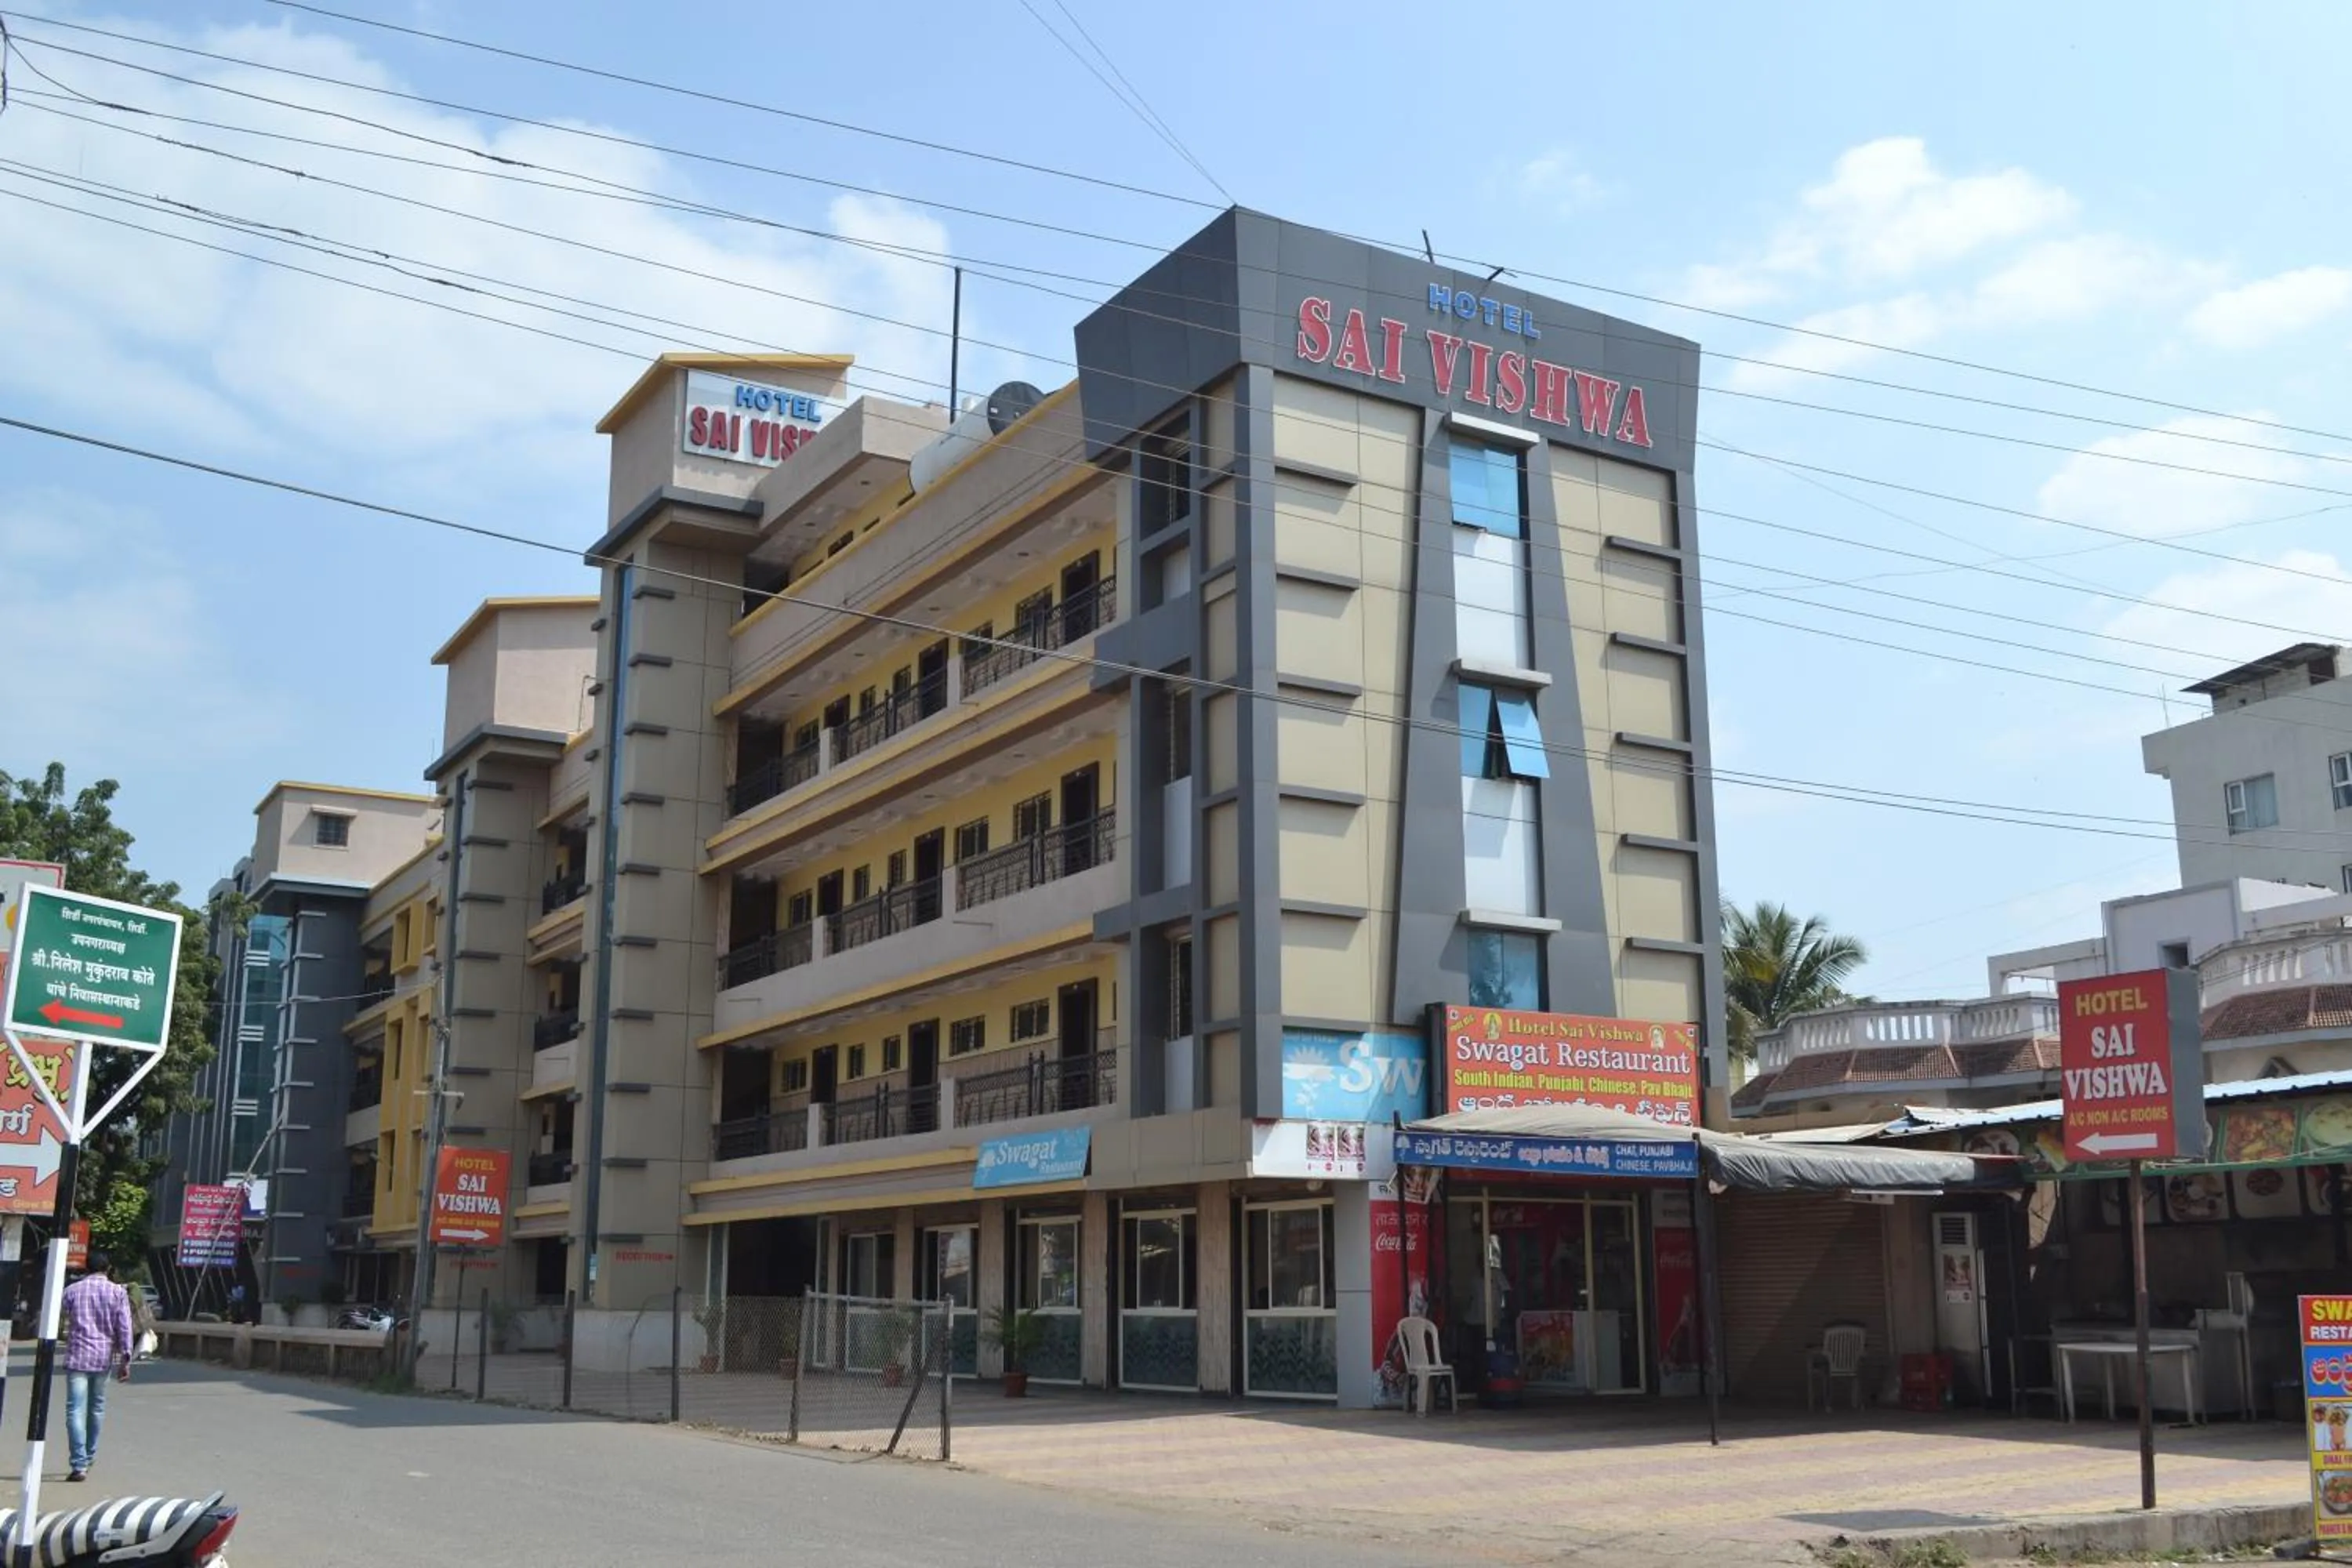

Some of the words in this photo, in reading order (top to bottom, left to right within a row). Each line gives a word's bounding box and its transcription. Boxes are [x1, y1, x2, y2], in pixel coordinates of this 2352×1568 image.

[1428, 283, 1541, 339] HOTEL
[1298, 297, 1406, 383] SAI
[1426, 330, 1652, 448] VISHWA
[735, 385, 821, 422] HOTEL
[691, 406, 740, 452] SAI
[2075, 987, 2148, 1016] HOTEL
[1508, 1018, 1554, 1036] Hotel
[1559, 1024, 1583, 1038] Sai
[1588, 1025, 1643, 1042] Vishwa
[2091, 1023, 2135, 1058] SAI
[1457, 1036, 1549, 1071] Swagat
[1556, 1043, 1690, 1074] Restaurant
[1455, 1069, 1490, 1087] South
[1641, 1080, 1661, 1095] Pav
[2065, 1061, 2167, 1101] VISHWA
[2088, 1110, 2109, 1125] NON
[2131, 1106, 2168, 1122] ROOMS
[455, 1157, 497, 1171] HOTEL
[996, 1138, 1058, 1168] Swagat
[1639, 1145, 1674, 1156] PUNJABI
[457, 1174, 488, 1192] SAI
[437, 1192, 502, 1214] VISHWA
